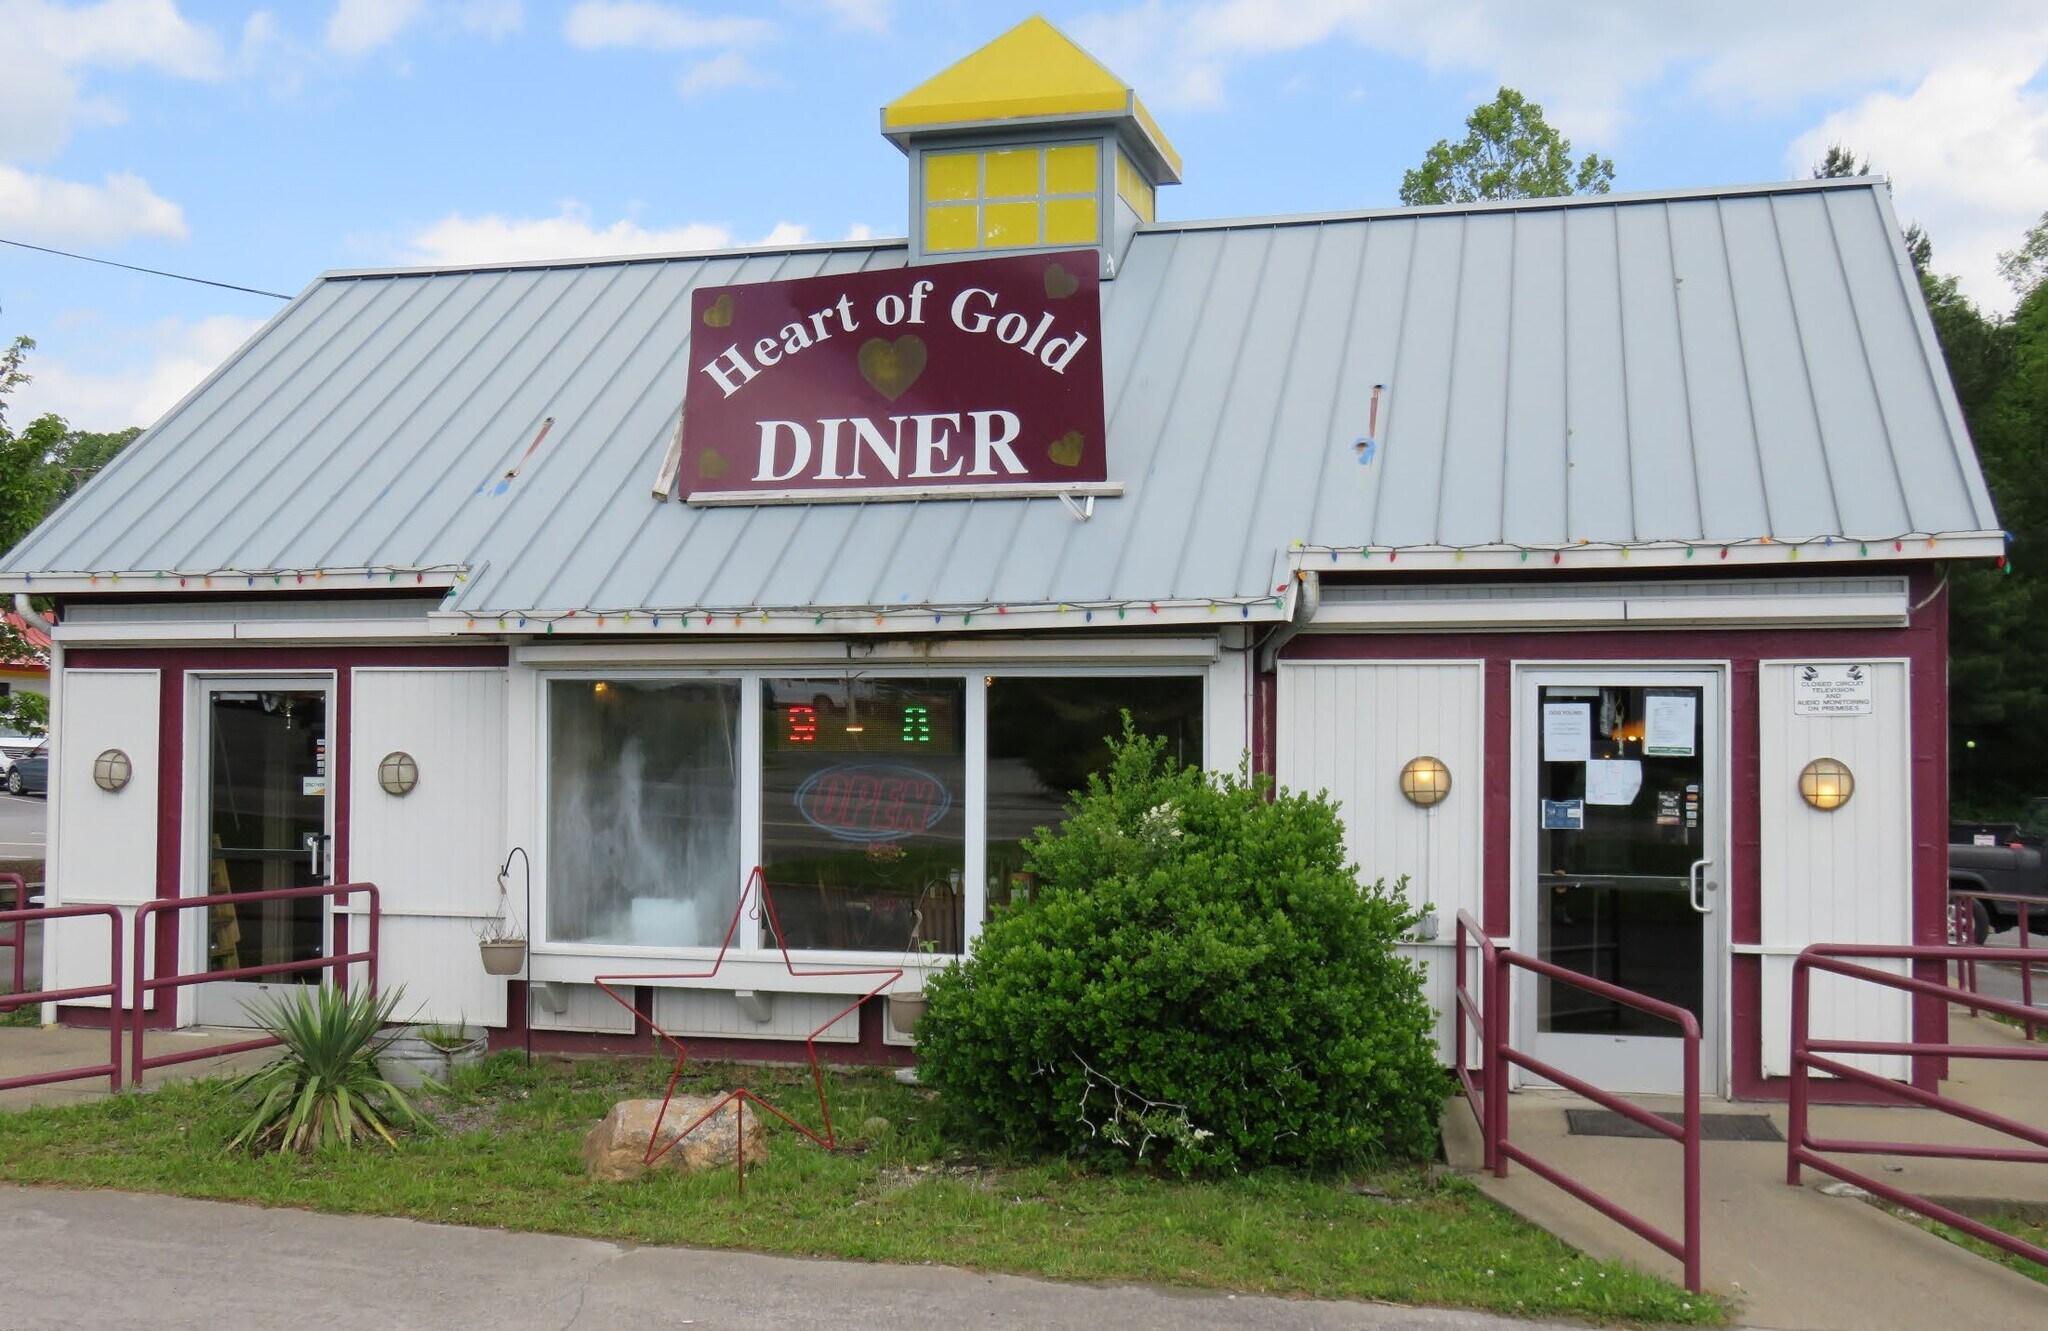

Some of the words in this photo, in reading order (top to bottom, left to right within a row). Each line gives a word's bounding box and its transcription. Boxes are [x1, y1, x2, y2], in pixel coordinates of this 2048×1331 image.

[700, 293, 860, 399] Heart
[875, 280, 934, 326] of
[950, 287, 1088, 375] Gold
[751, 410, 1029, 482] DINER
[812, 773, 936, 834] OPEN
